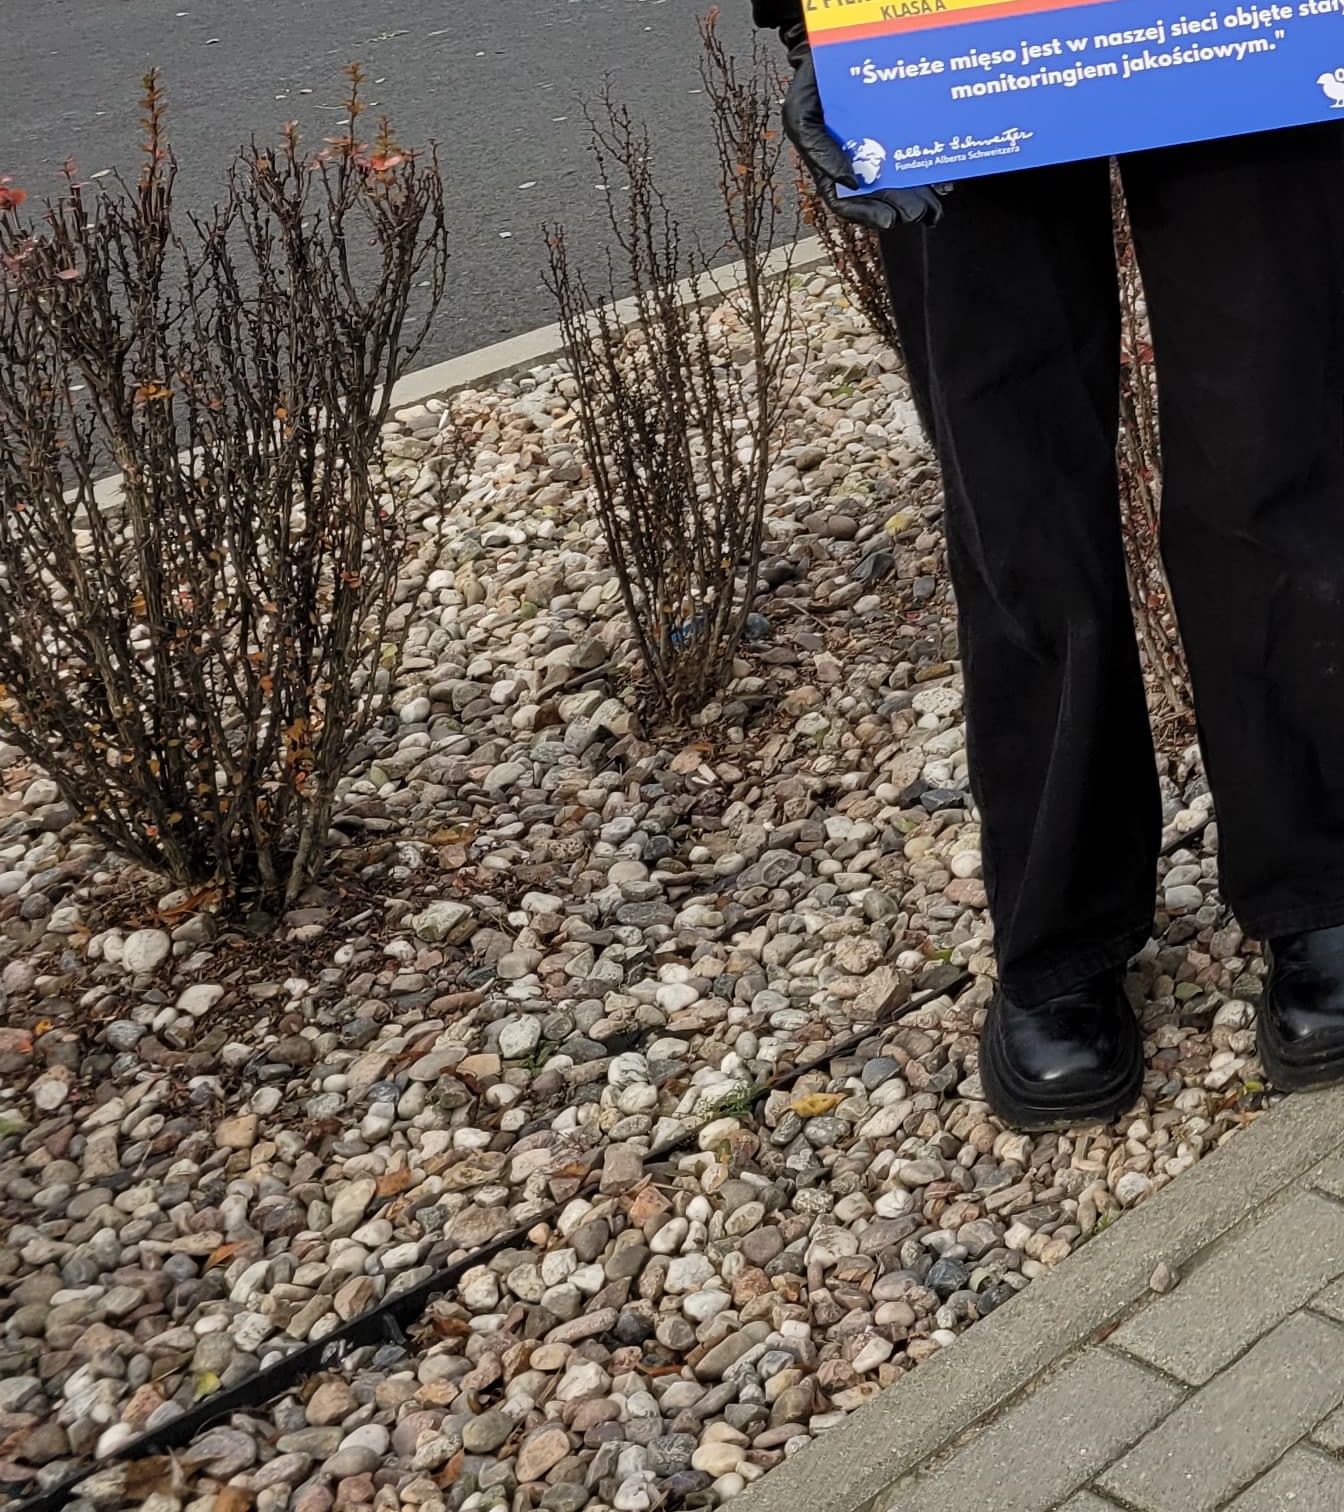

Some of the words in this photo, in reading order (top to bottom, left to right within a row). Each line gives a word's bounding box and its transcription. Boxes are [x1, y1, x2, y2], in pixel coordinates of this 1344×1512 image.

[880, 0, 933, 21] KLASA
[850, 58, 945, 85] "Świeże
[950, 47, 1017, 72] mięso
[1021, 37, 1062, 65] jest
[1066, 37, 1088, 52] w
[1093, 20, 1165, 48] naszej
[1170, 11, 1219, 37] sieci
[1223, 6, 1293, 29] objęte
[950, 62, 1118, 100] monitoringiem
[1121, 29, 1285, 78] jakościowym."
[895, 156, 934, 172] Fundacja
[934, 152, 967, 166] Alberta
[967, 145, 1021, 161] Schweitzera
